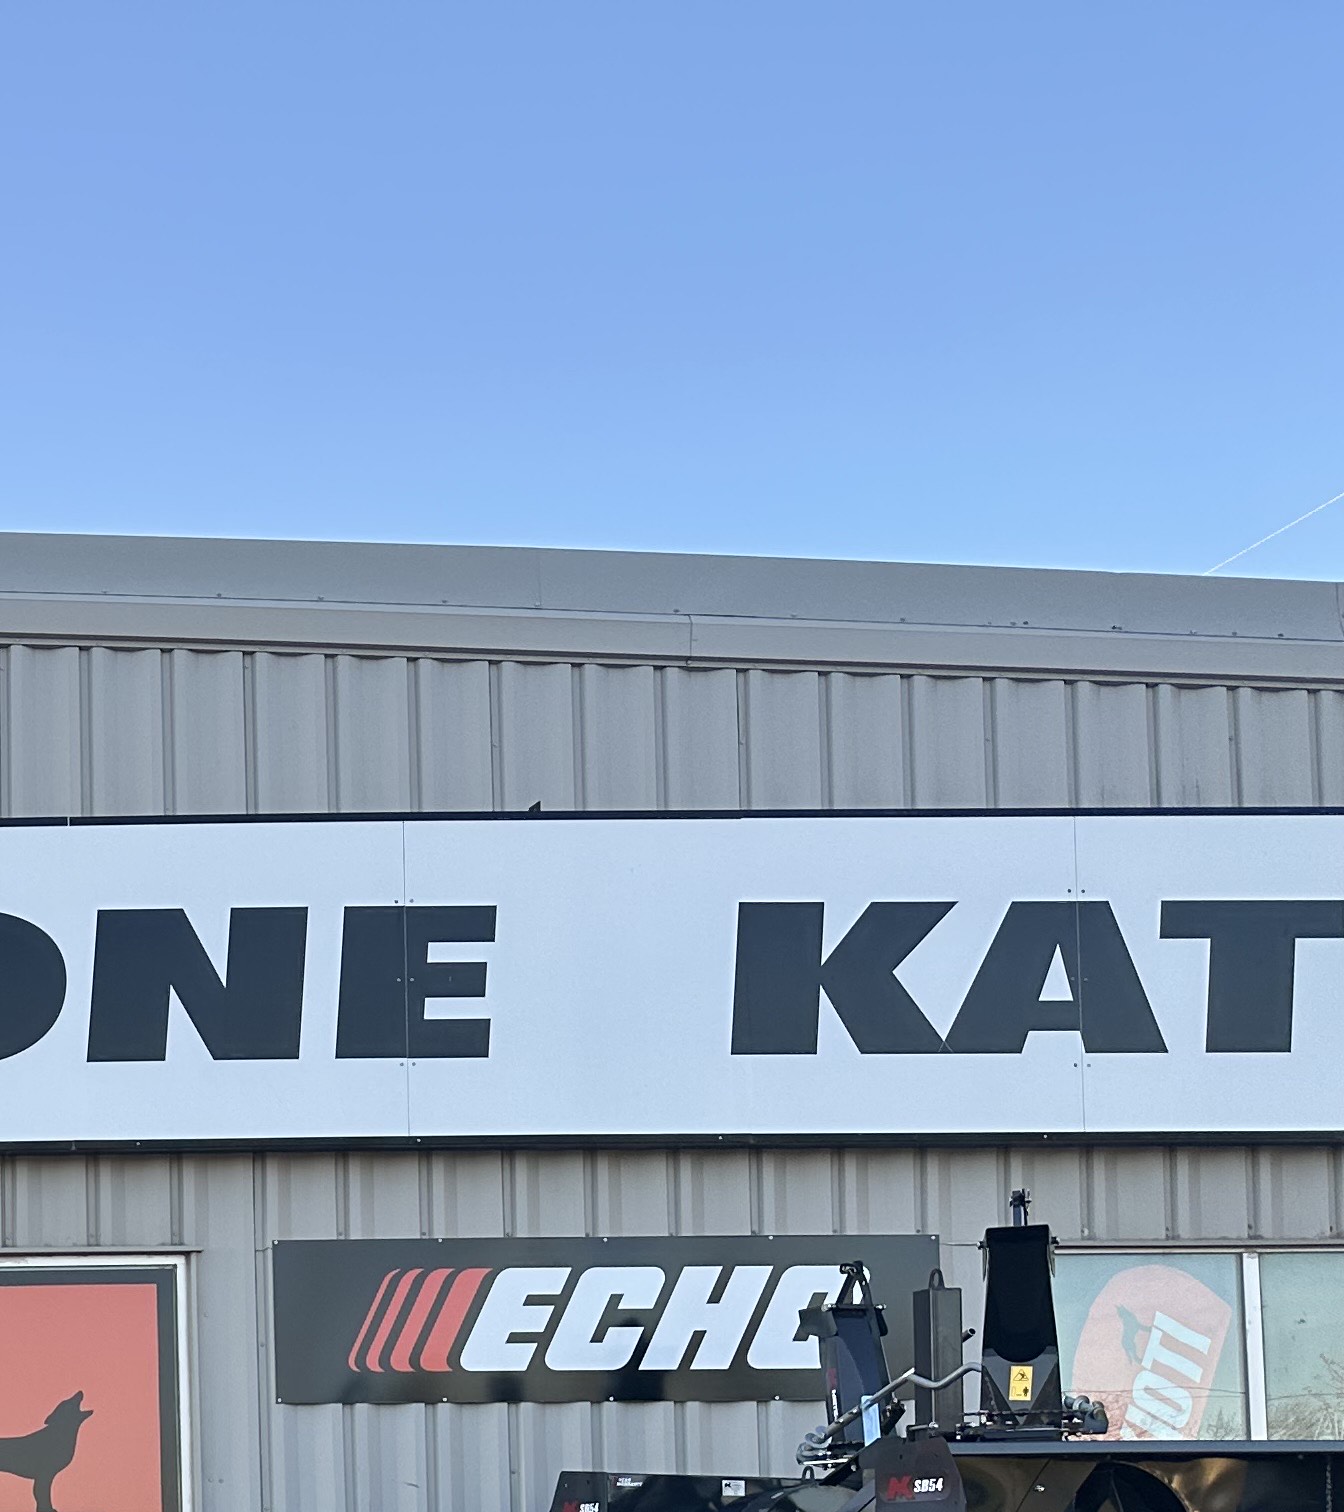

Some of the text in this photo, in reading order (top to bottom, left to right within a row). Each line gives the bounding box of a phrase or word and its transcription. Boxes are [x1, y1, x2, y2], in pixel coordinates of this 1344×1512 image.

[731, 899, 1344, 1055] KAT
[1119, 1310, 1212, 1441] IOTI
[913, 1477, 944, 1493] SB54
